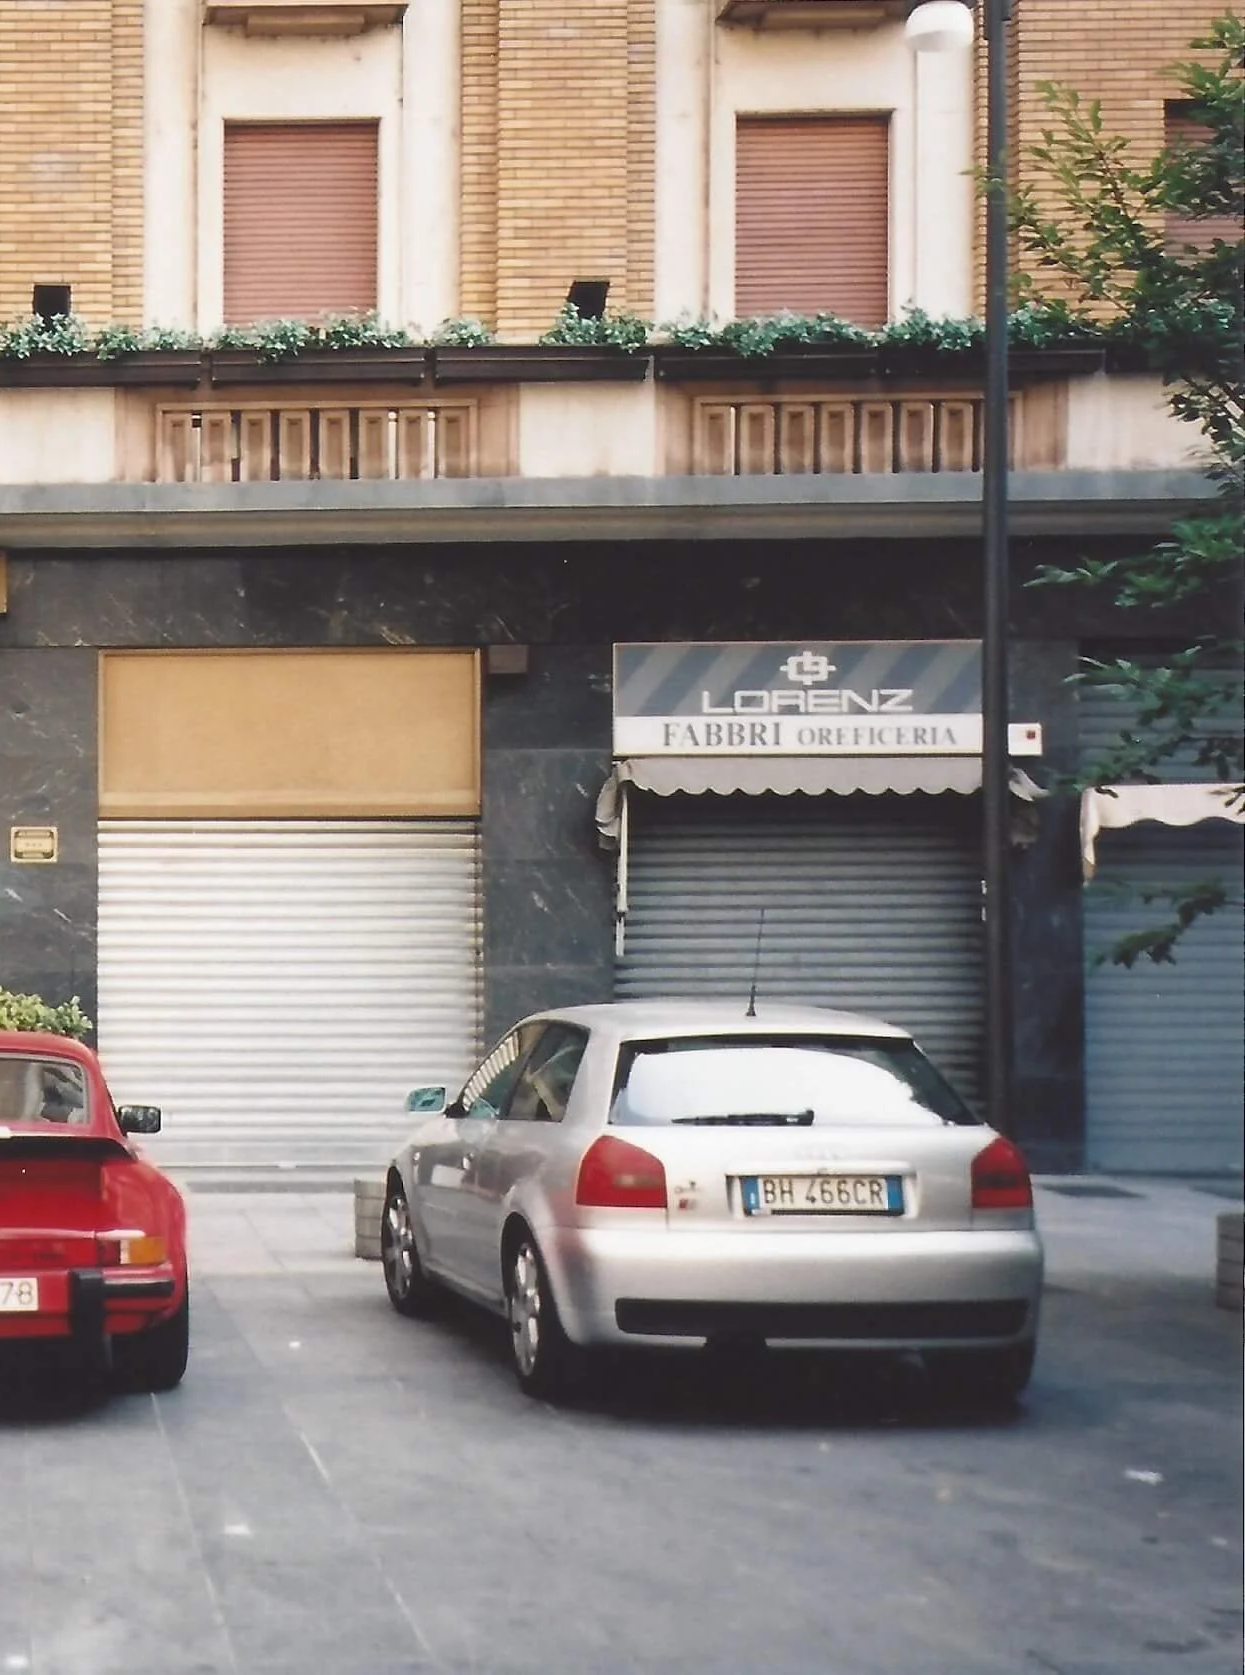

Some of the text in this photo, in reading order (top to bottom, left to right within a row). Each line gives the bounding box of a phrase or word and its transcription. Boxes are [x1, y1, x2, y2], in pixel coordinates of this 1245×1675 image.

[701, 688, 914, 714] LORENZ
[662, 721, 958, 747] FABBRI OREFICERIA
[762, 1179, 794, 1205] BH
[805, 1178, 884, 1205] 466CR
